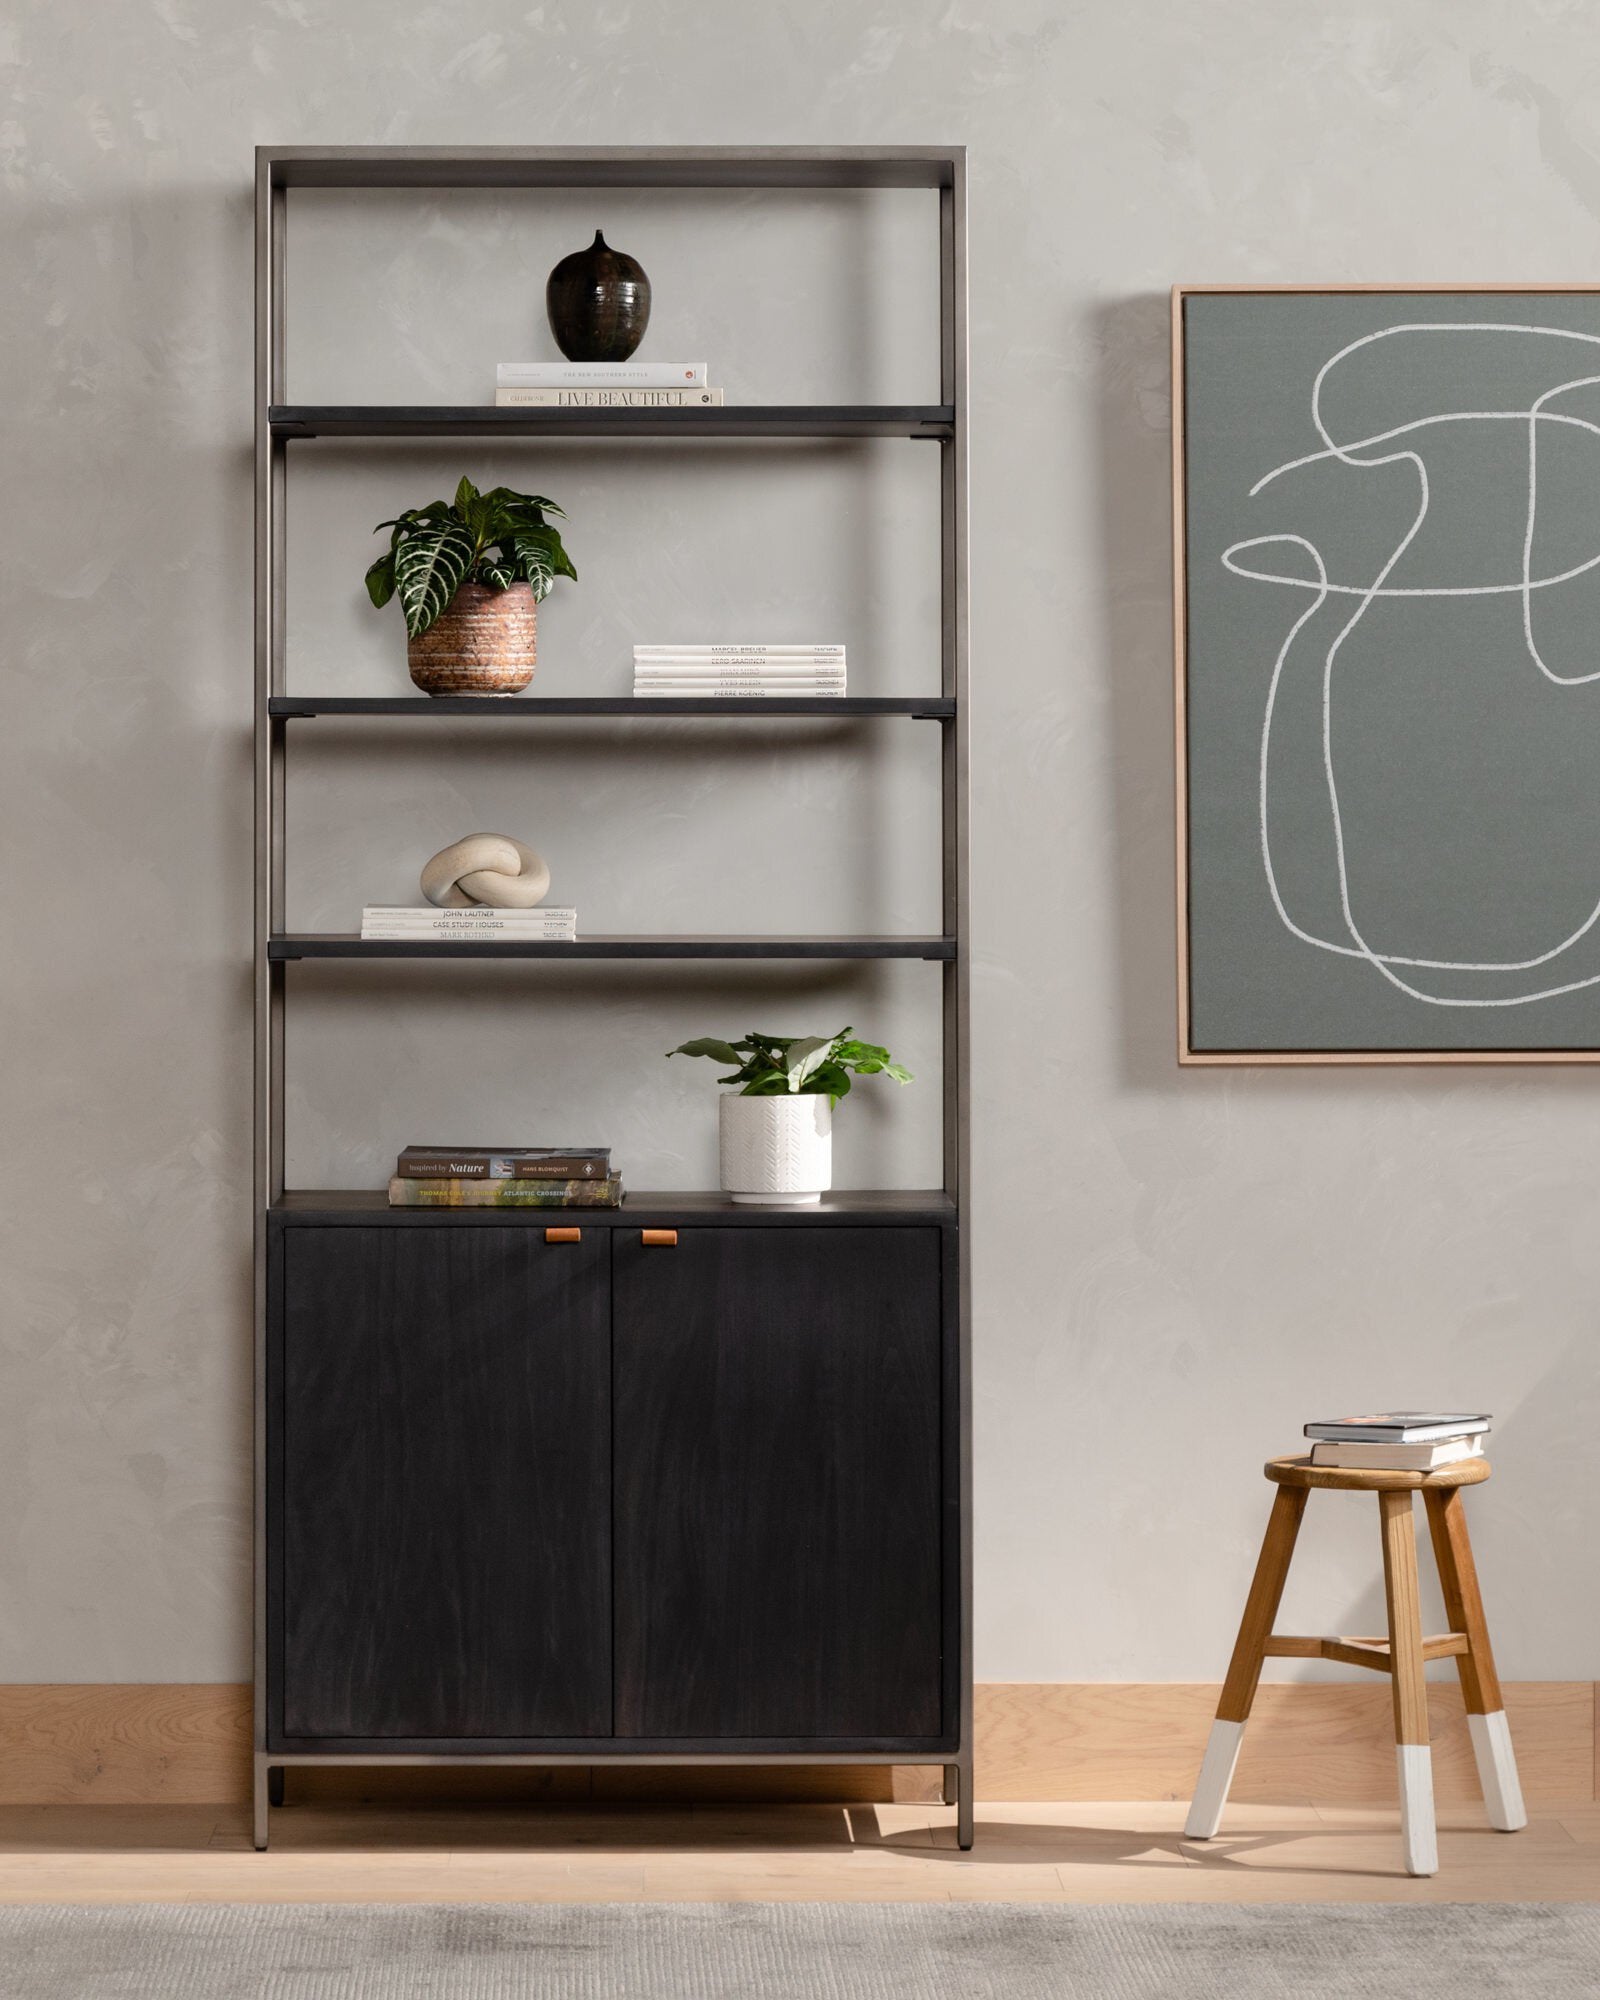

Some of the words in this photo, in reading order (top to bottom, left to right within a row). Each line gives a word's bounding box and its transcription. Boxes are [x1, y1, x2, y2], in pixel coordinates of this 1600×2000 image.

[558, 392, 594, 406] LIVE
[598, 392, 688, 406] BEAUTIFUL
[443, 910, 463, 918] JOHN
[440, 931, 462, 939] MARK
[463, 931, 495, 939] ROTHKO
[409, 1163, 437, 1173] Inspired
[438, 1164, 447, 1172] by
[448, 1163, 485, 1173] Nature
